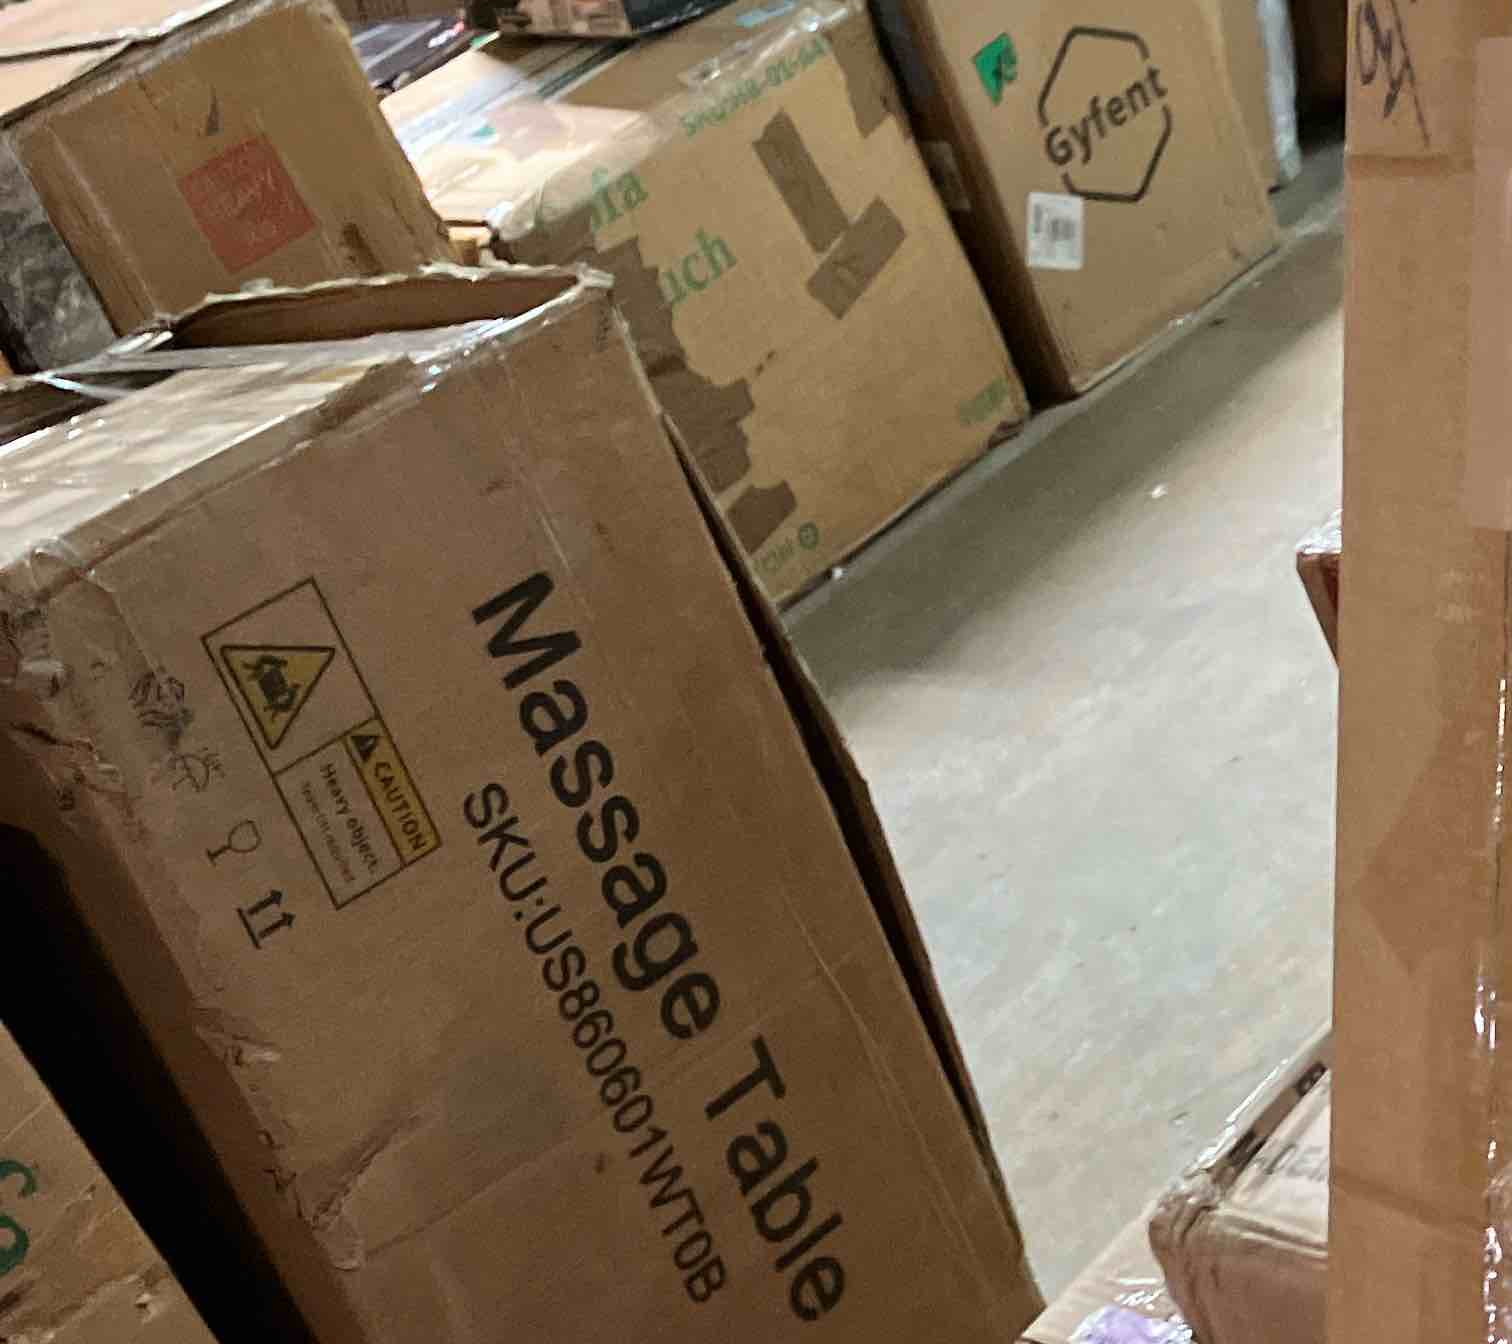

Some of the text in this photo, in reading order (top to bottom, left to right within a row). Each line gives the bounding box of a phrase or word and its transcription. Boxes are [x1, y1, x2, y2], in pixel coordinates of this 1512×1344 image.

[1043, 65, 1170, 169] Gyfent
[320, 762, 348, 817] Heavy
[374, 760, 426, 852] CAUTION
[471, 569, 849, 1324] Massage Table
